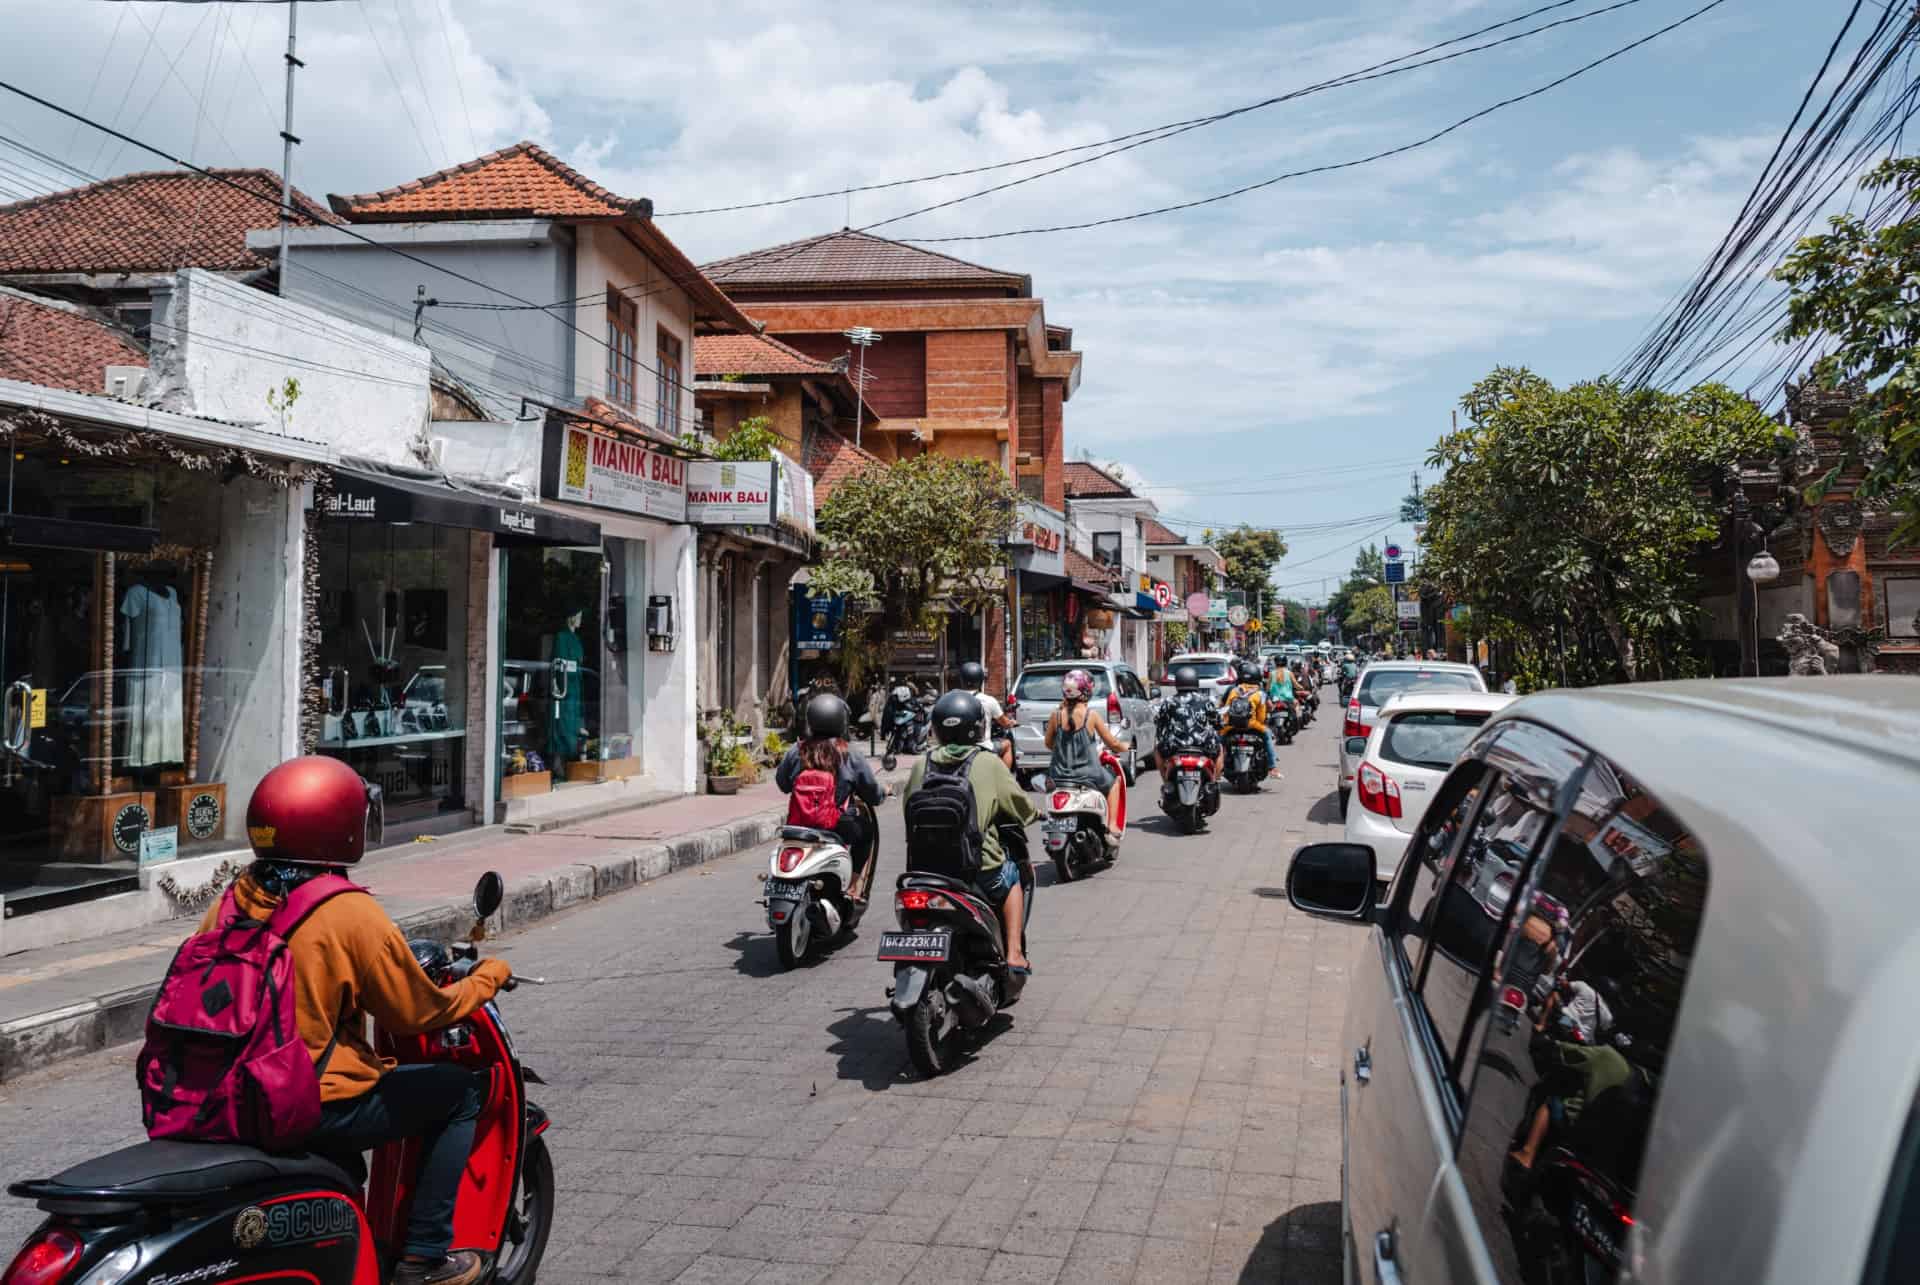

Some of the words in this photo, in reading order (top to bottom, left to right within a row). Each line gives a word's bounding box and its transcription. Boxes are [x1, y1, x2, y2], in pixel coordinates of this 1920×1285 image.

[592, 437, 647, 478] MANIK
[651, 455, 684, 486] BALI
[323, 493, 376, 511] al-Laut
[687, 491, 733, 503] MANIK
[736, 491, 768, 503] BALI
